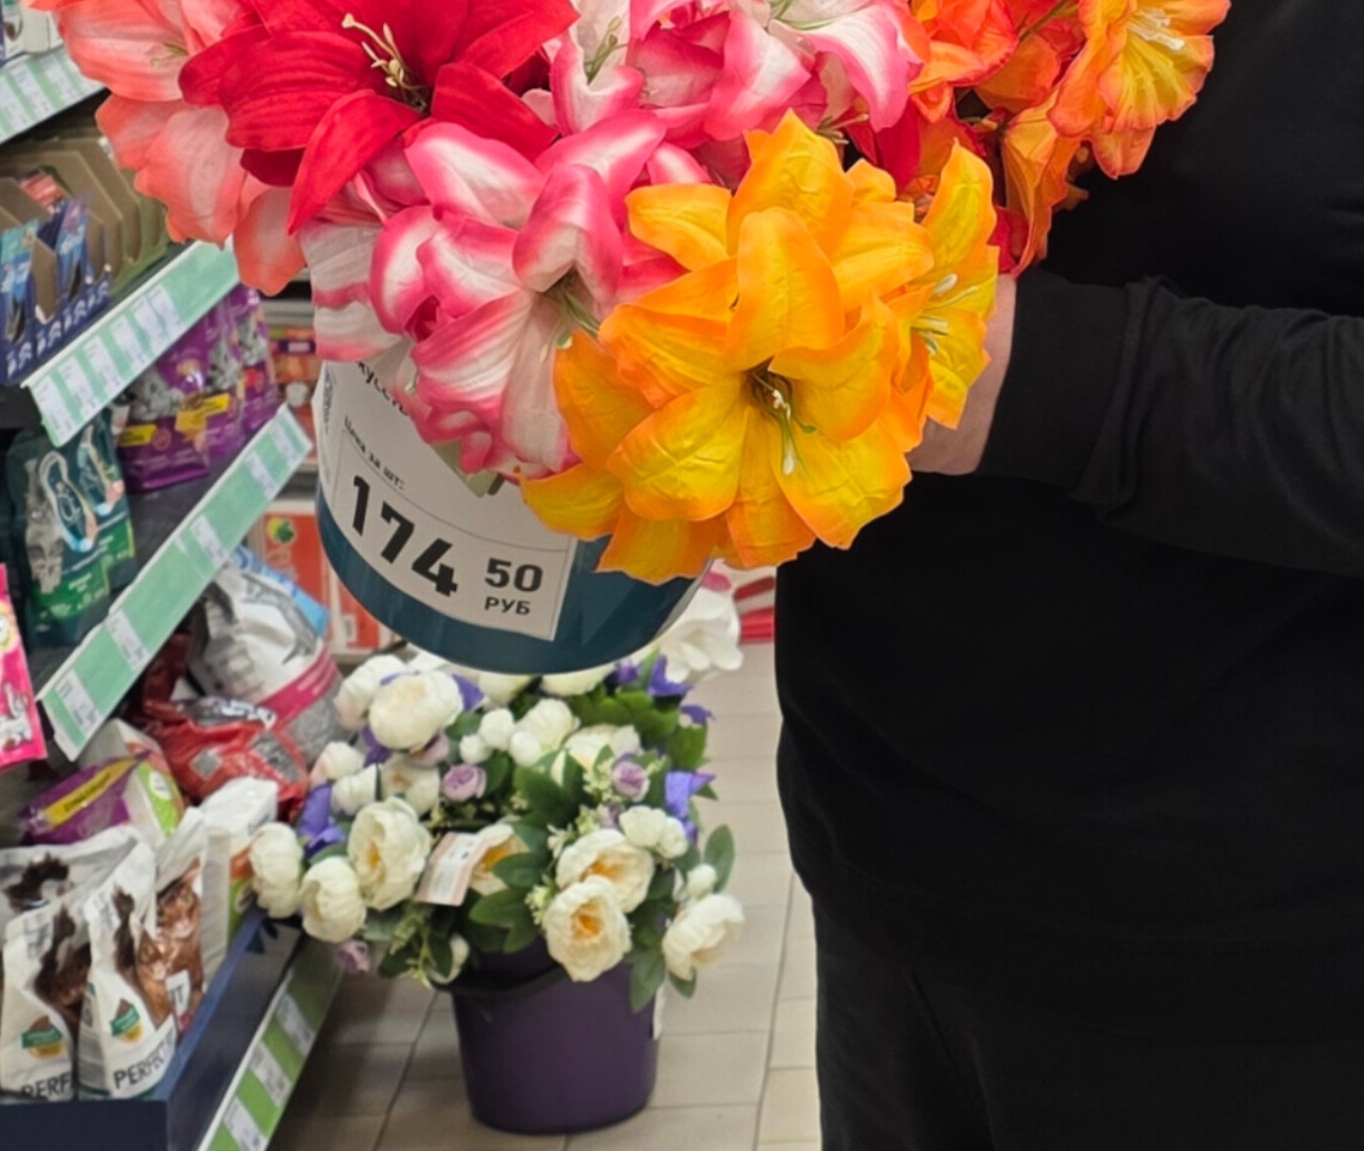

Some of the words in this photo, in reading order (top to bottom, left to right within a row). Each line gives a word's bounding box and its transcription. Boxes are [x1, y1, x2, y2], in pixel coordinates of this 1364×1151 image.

[353, 475, 459, 597] 174
[485, 557, 544, 593] 50
[484, 596, 532, 616] РУБ
